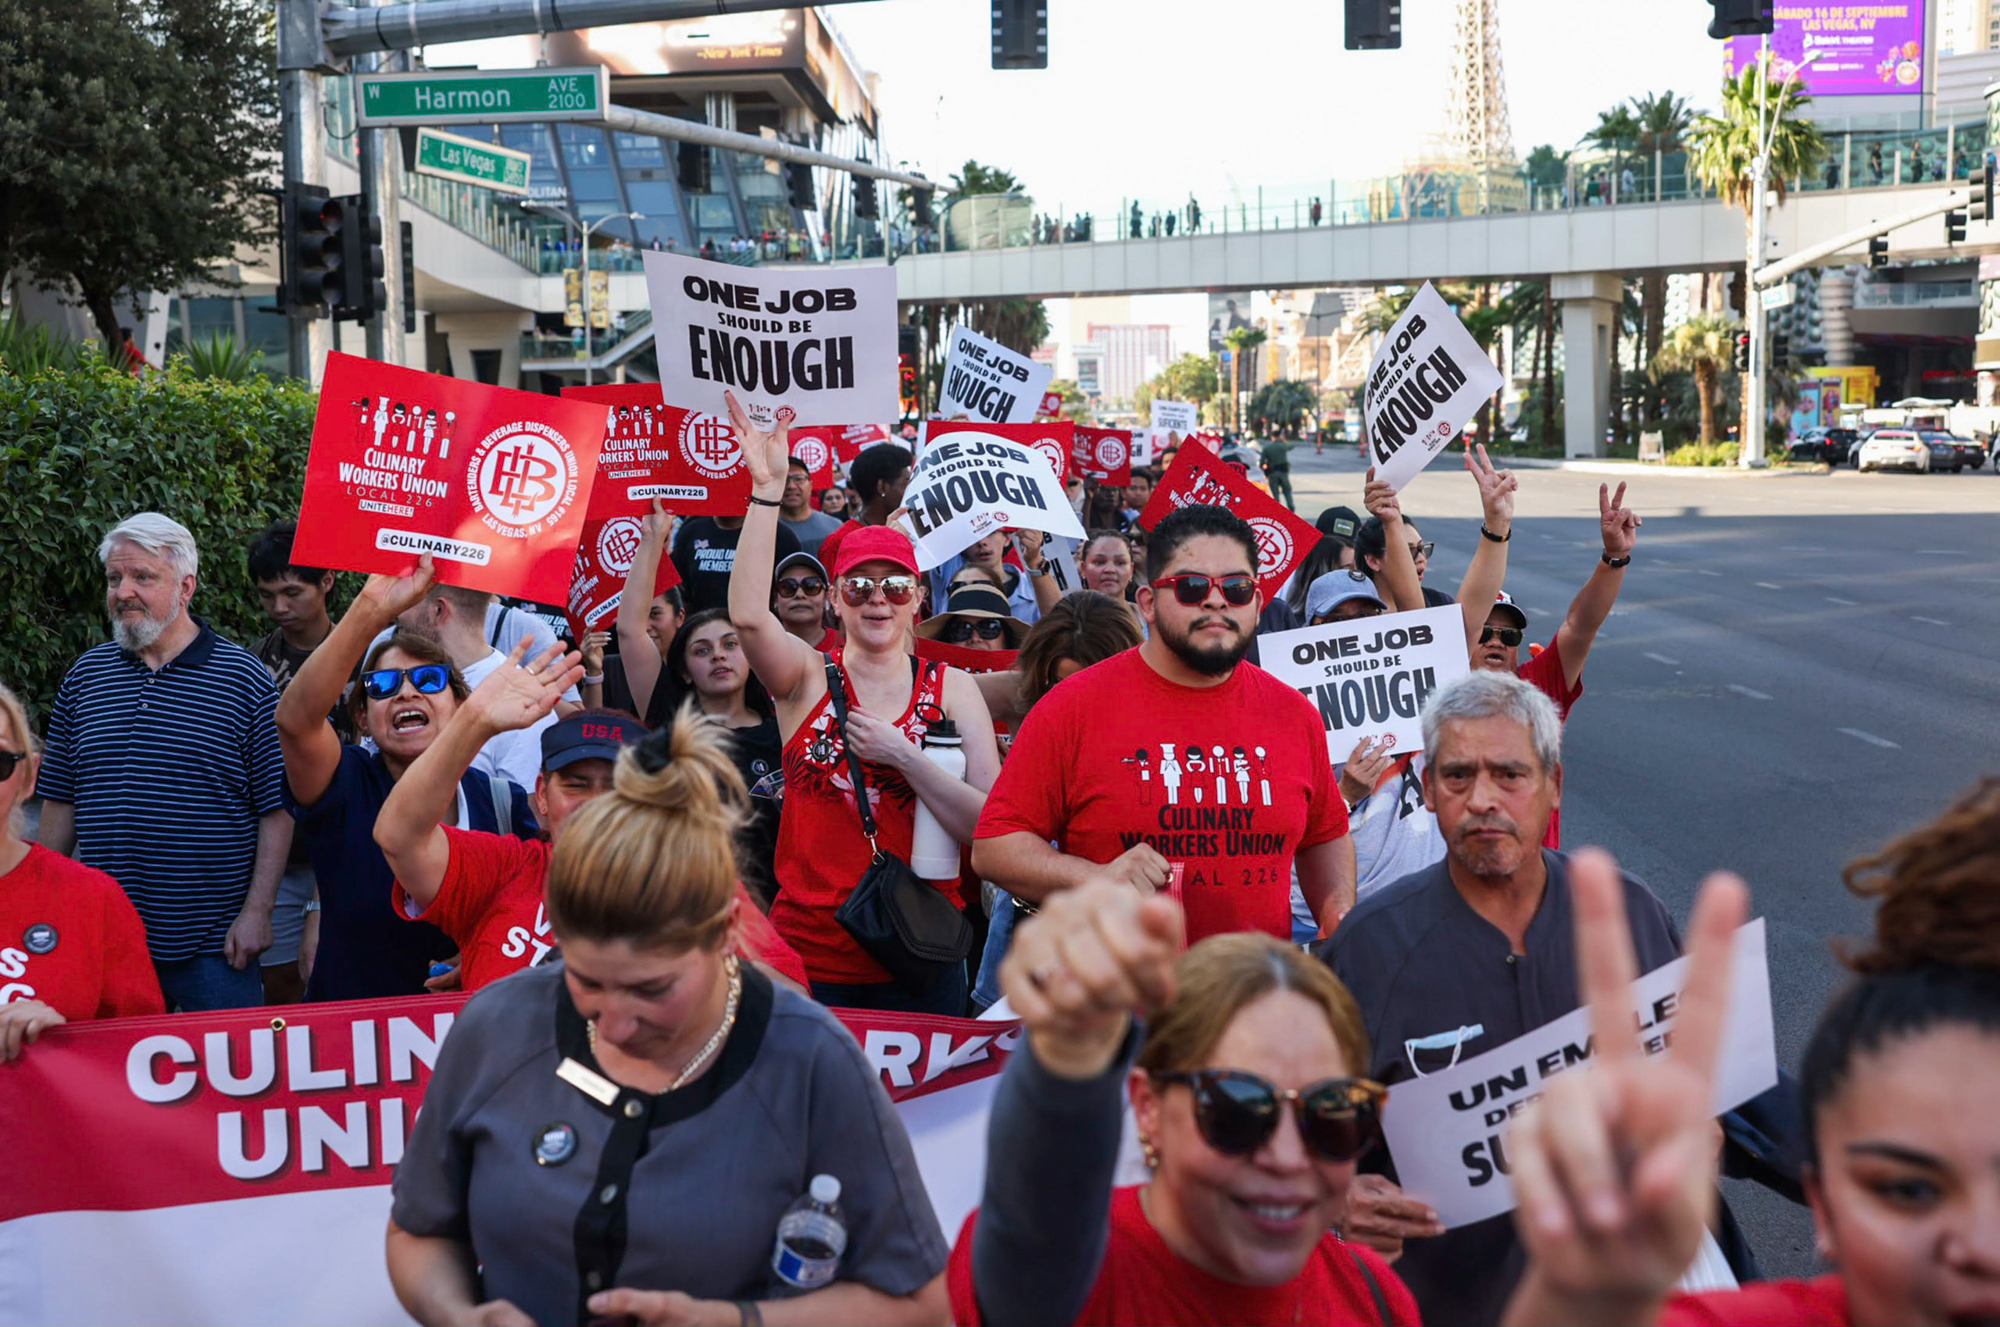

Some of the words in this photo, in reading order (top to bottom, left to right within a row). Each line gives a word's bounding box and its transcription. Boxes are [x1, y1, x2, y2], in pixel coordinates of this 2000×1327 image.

[1802, 19, 1821, 30] LAS
[1845, 6, 1908, 18] SEPTIEMBRE
[368, 84, 380, 99] W
[548, 77, 578, 93] AVE
[415, 86, 511, 110] Harmon
[548, 94, 586, 109] 2100
[422, 138, 429, 150] S
[441, 142, 460, 165] Las
[463, 147, 496, 176] Vegas
[683, 275, 761, 312] ONE
[764, 288, 857, 314] JOB
[717, 312, 783, 333] SHOULD
[788, 320, 812, 333] BE
[688, 324, 854, 396] ENOUGH
[958, 338, 988, 363] ONE
[985, 356, 1030, 382] JOB
[962, 359, 989, 377] SHOULD
[990, 373, 1003, 384] BE
[1365, 359, 1391, 412] ONE
[1389, 314, 1427, 369] JOB
[1375, 368, 1403, 408] SHOULD
[1402, 353, 1417, 372] BE
[947, 365, 1017, 423] ENOUGH
[1371, 345, 1468, 465] ENOUGH
[480, 421, 523, 450] BEVERAGE
[525, 421, 571, 452] DISPENSERS
[604, 438, 651, 451] CULINARY
[364, 447, 426, 475] CULINARY
[475, 447, 486, 456] &
[564, 450, 579, 478] UNION
[599, 451, 635, 464] ORKERS
[638, 449, 670, 461] UNION
[966, 442, 1030, 464] JOB
[339, 462, 400, 490] WORKERS
[401, 473, 448, 498] UNION
[928, 459, 984, 481] SHOULD
[988, 459, 1005, 469] BE
[346, 485, 397, 502] LOCAL
[406, 495, 432, 508] 226
[467, 455, 484, 513] BARTENDERS
[561, 479, 578, 506] LOCAL
[631, 488, 705, 498] @CULINARY226
[546, 505, 566, 526] #165
[906, 470, 1047, 539] ENOUGH
[482, 513, 498, 529] LAS
[496, 523, 528, 538] VEGAS,
[529, 523, 543, 535] NV
[381, 533, 485, 560] @CULINARY226
[694, 549, 725, 560] PROUD
[1292, 635, 1359, 665] ONE
[1363, 624, 1434, 654] JOB
[1324, 658, 1380, 677] SHOULD
[1383, 654, 1402, 667] BE
[1298, 666, 1437, 731] NOUGH
[1158, 805, 1254, 830] CULINARY
[1226, 831, 1286, 857] UNION
[1242, 867, 1277, 885] 226
[1448, 1065, 1528, 1111] UN
